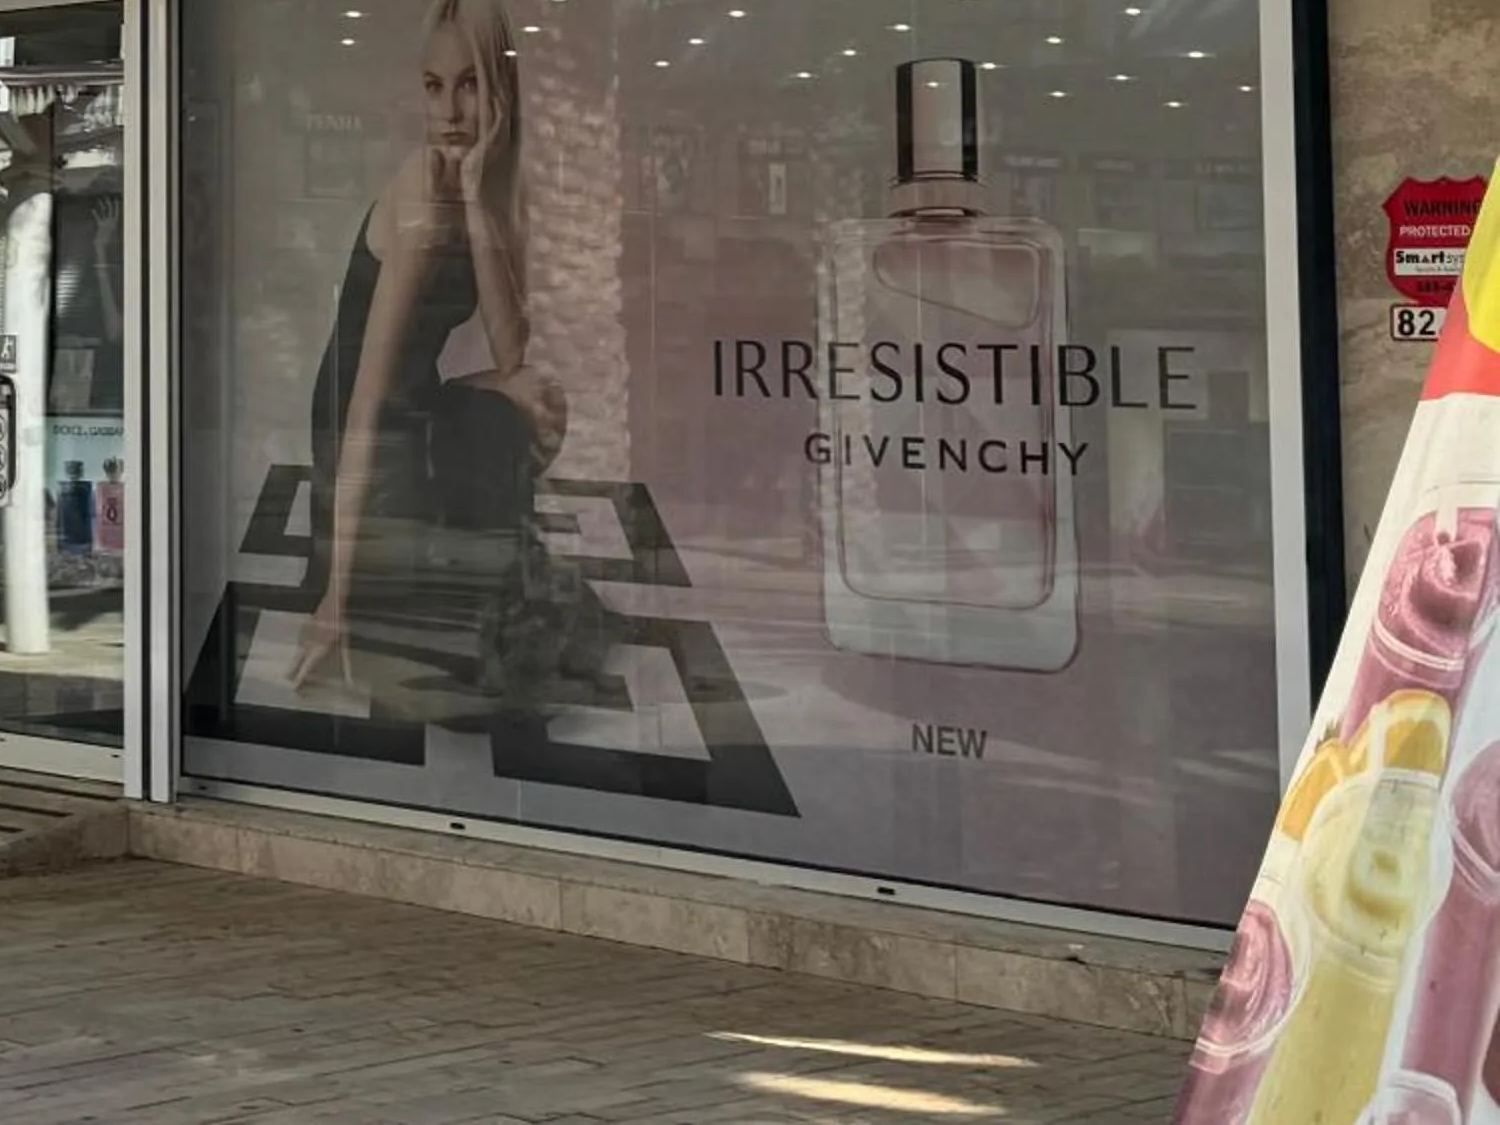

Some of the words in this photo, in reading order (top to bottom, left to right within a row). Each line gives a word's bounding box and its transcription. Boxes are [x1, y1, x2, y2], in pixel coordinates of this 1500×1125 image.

[1399, 225, 1471, 238] PROTECTED
[1397, 309, 1437, 337] 82
[712, 339, 1198, 411] IRRESISTIBLE
[804, 431, 1089, 476] GIVENCHY
[911, 723, 988, 759] NEW
